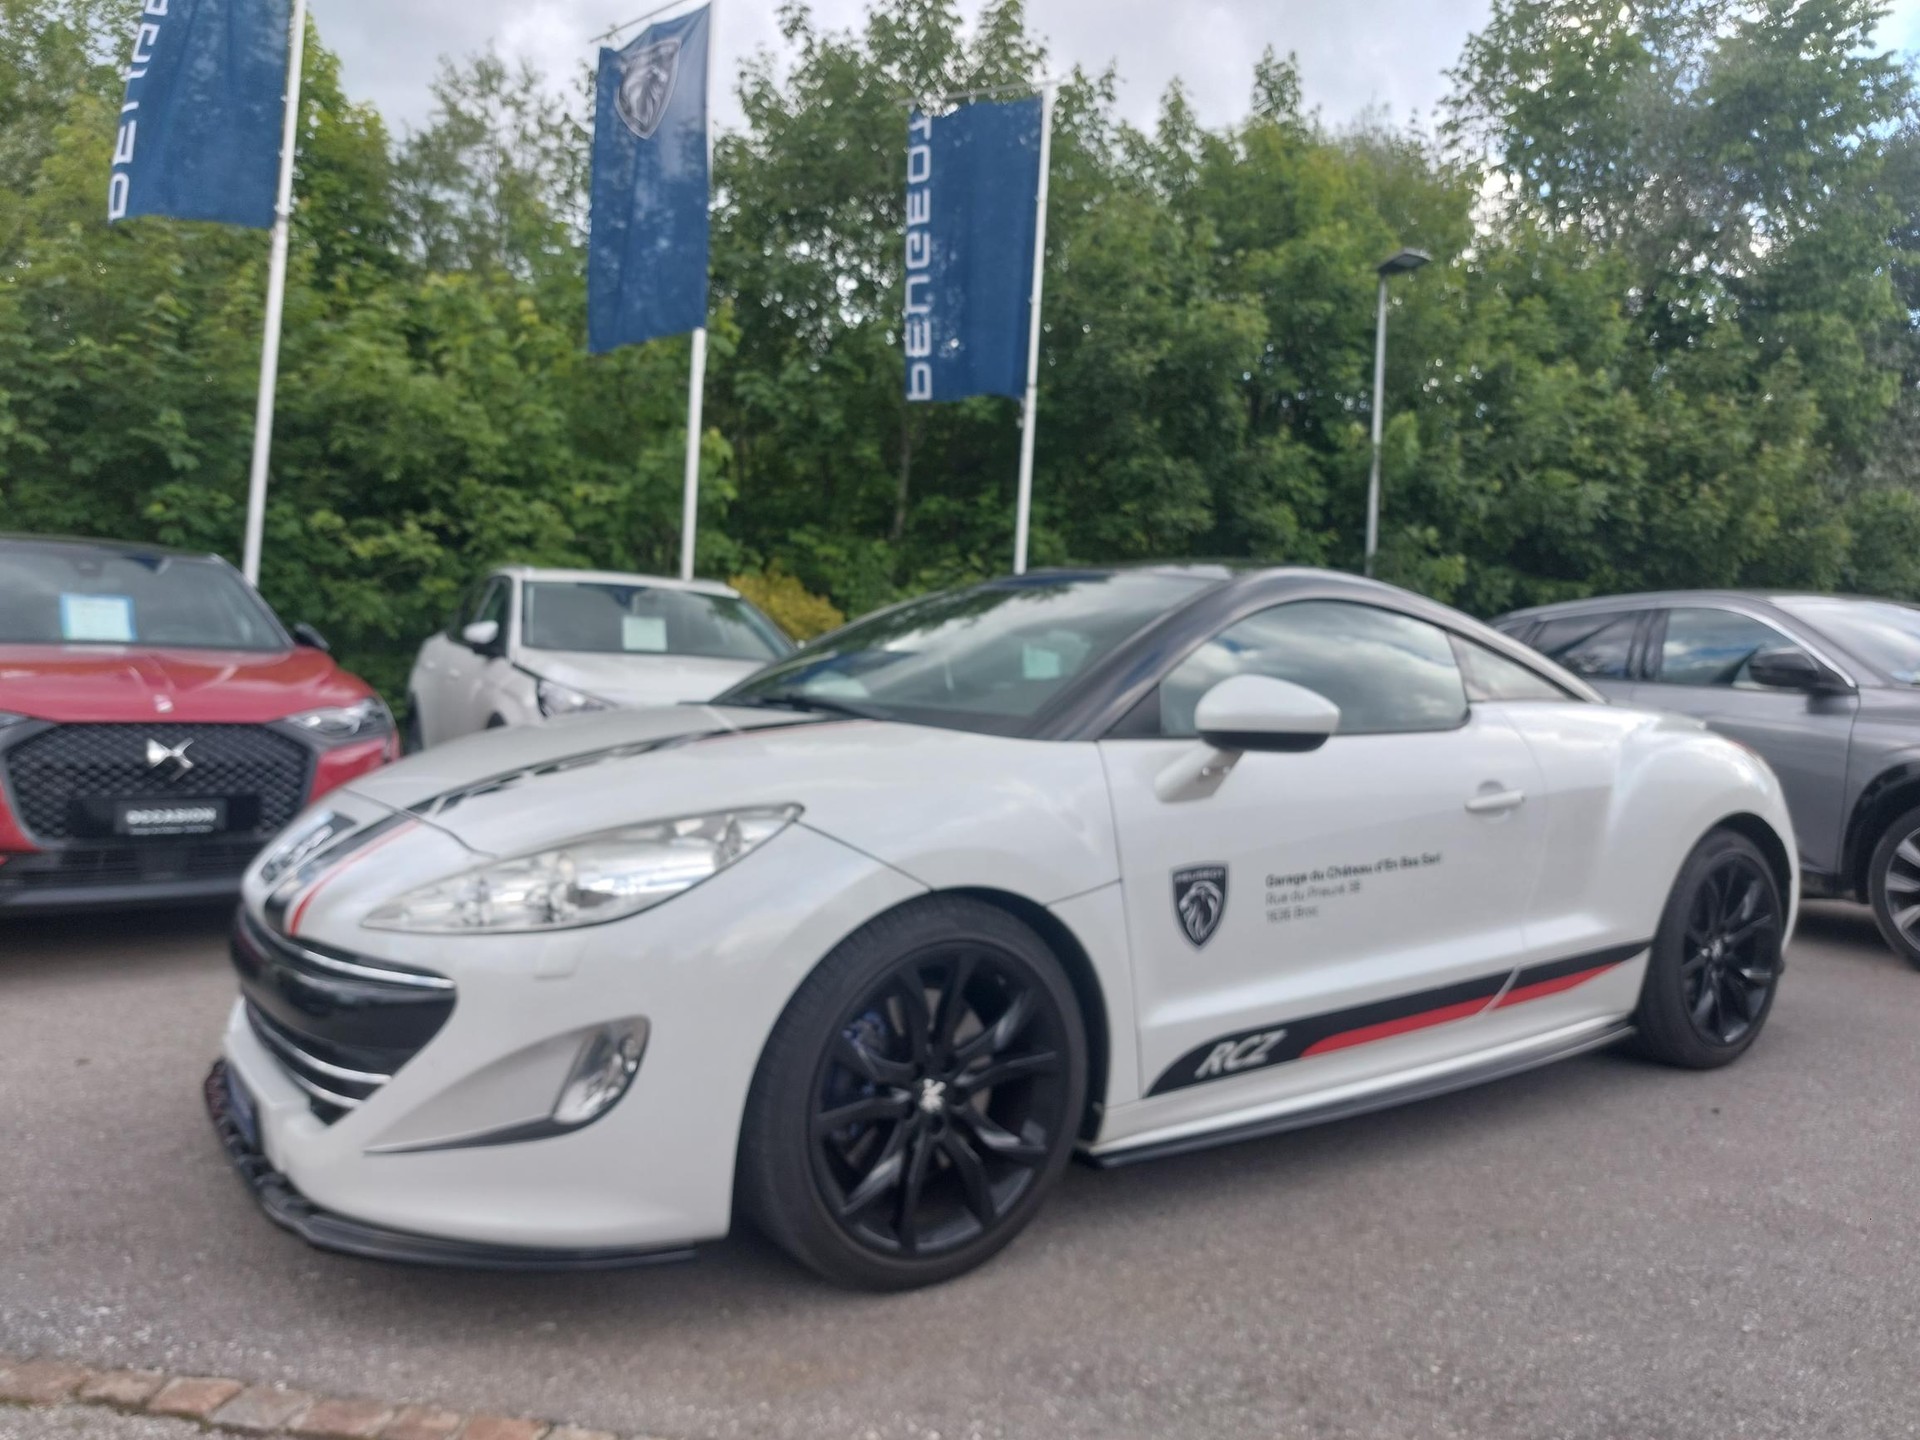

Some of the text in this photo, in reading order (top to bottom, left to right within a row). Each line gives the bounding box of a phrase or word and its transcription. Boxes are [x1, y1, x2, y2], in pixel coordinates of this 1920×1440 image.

[1265, 873, 1308, 889] Garage
[1309, 869, 1325, 883] du
[1326, 863, 1372, 880] Château
[1195, 1029, 1287, 1079] RCZ
